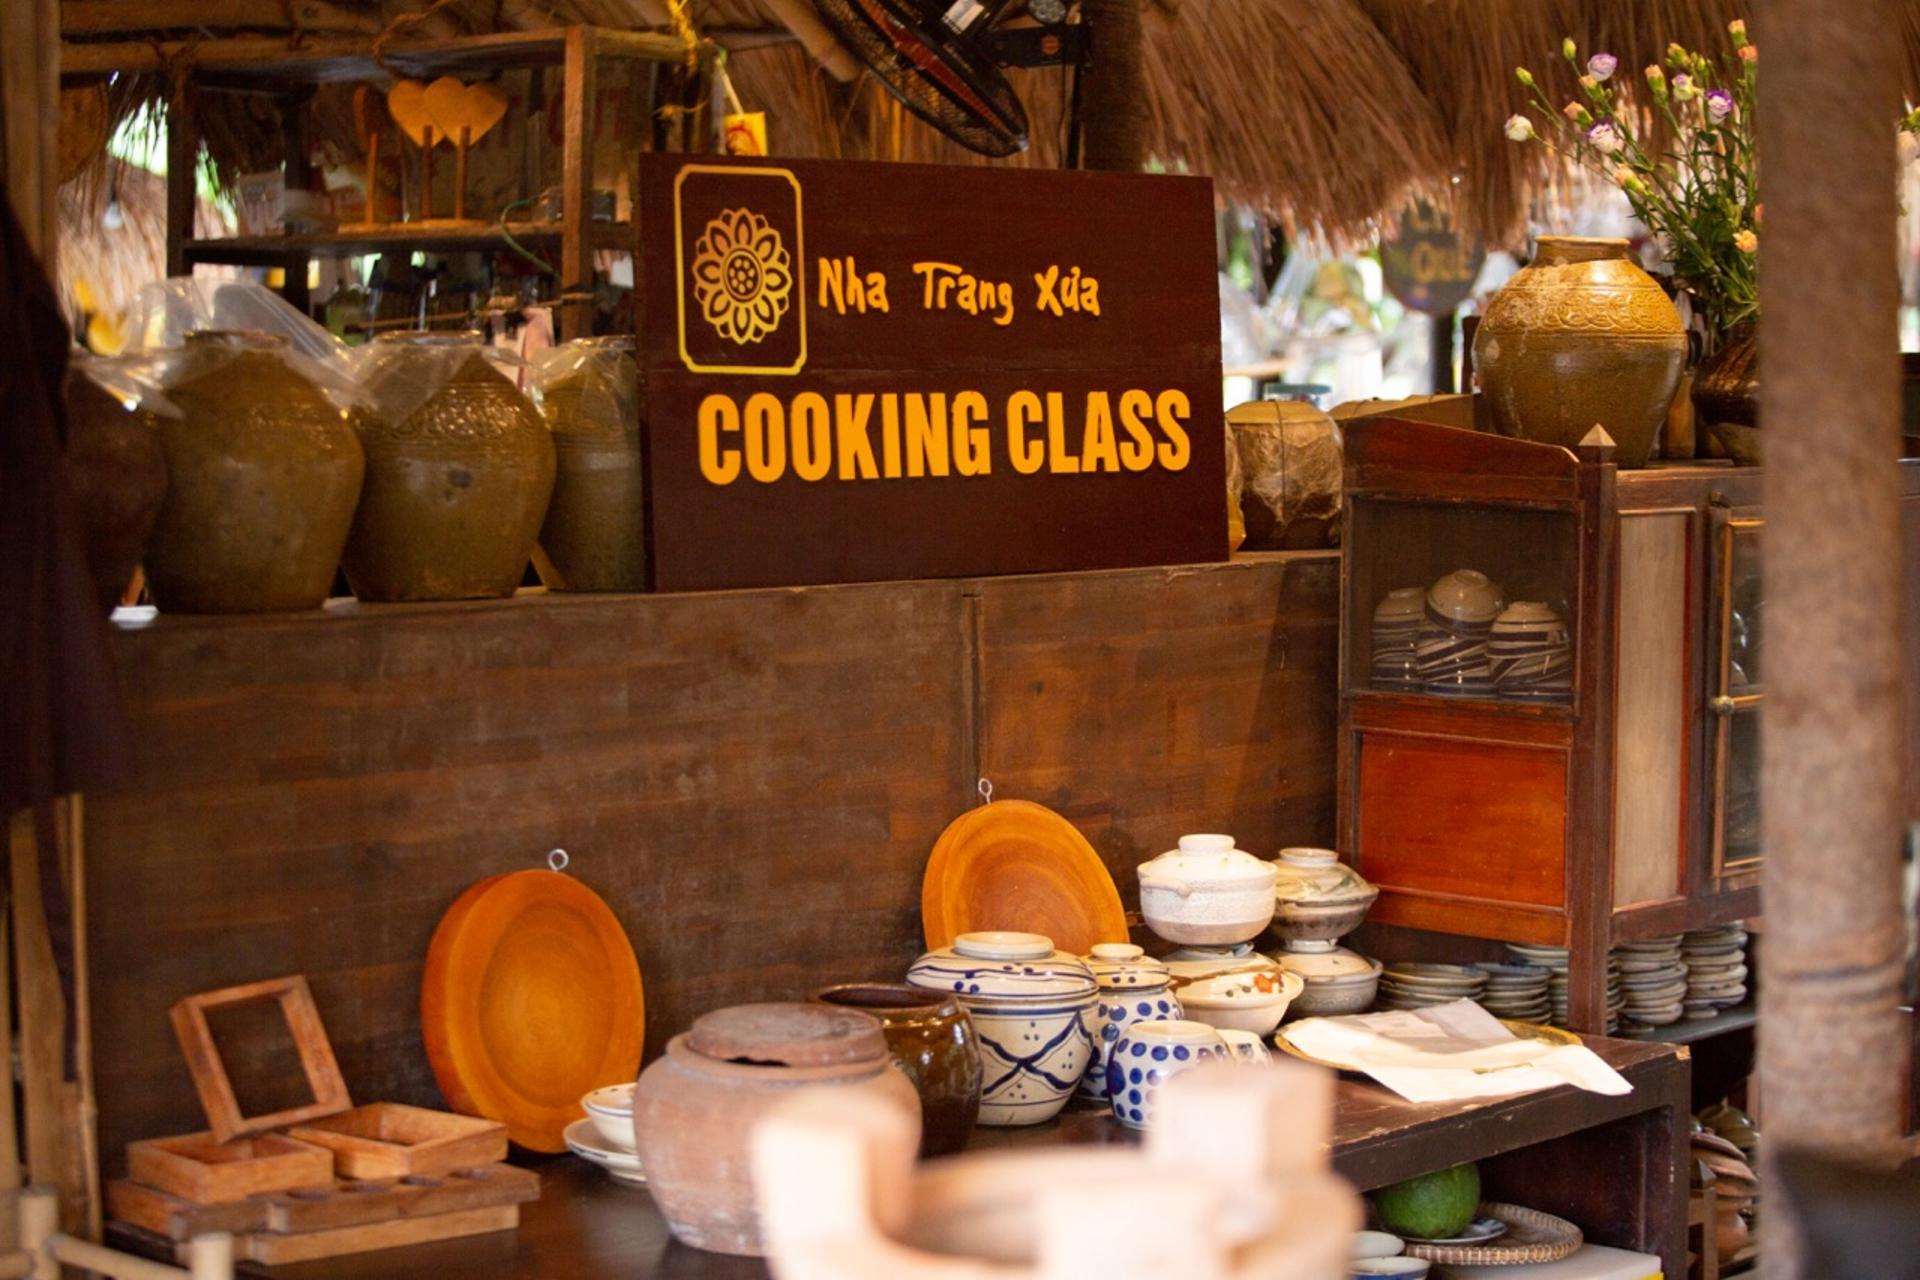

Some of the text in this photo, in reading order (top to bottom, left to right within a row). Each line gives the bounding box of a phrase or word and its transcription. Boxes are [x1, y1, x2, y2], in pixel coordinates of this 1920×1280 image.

[818, 256, 890, 315] Nha
[912, 261, 1014, 326] Trang
[698, 389, 1191, 485] COOKING CLASS
